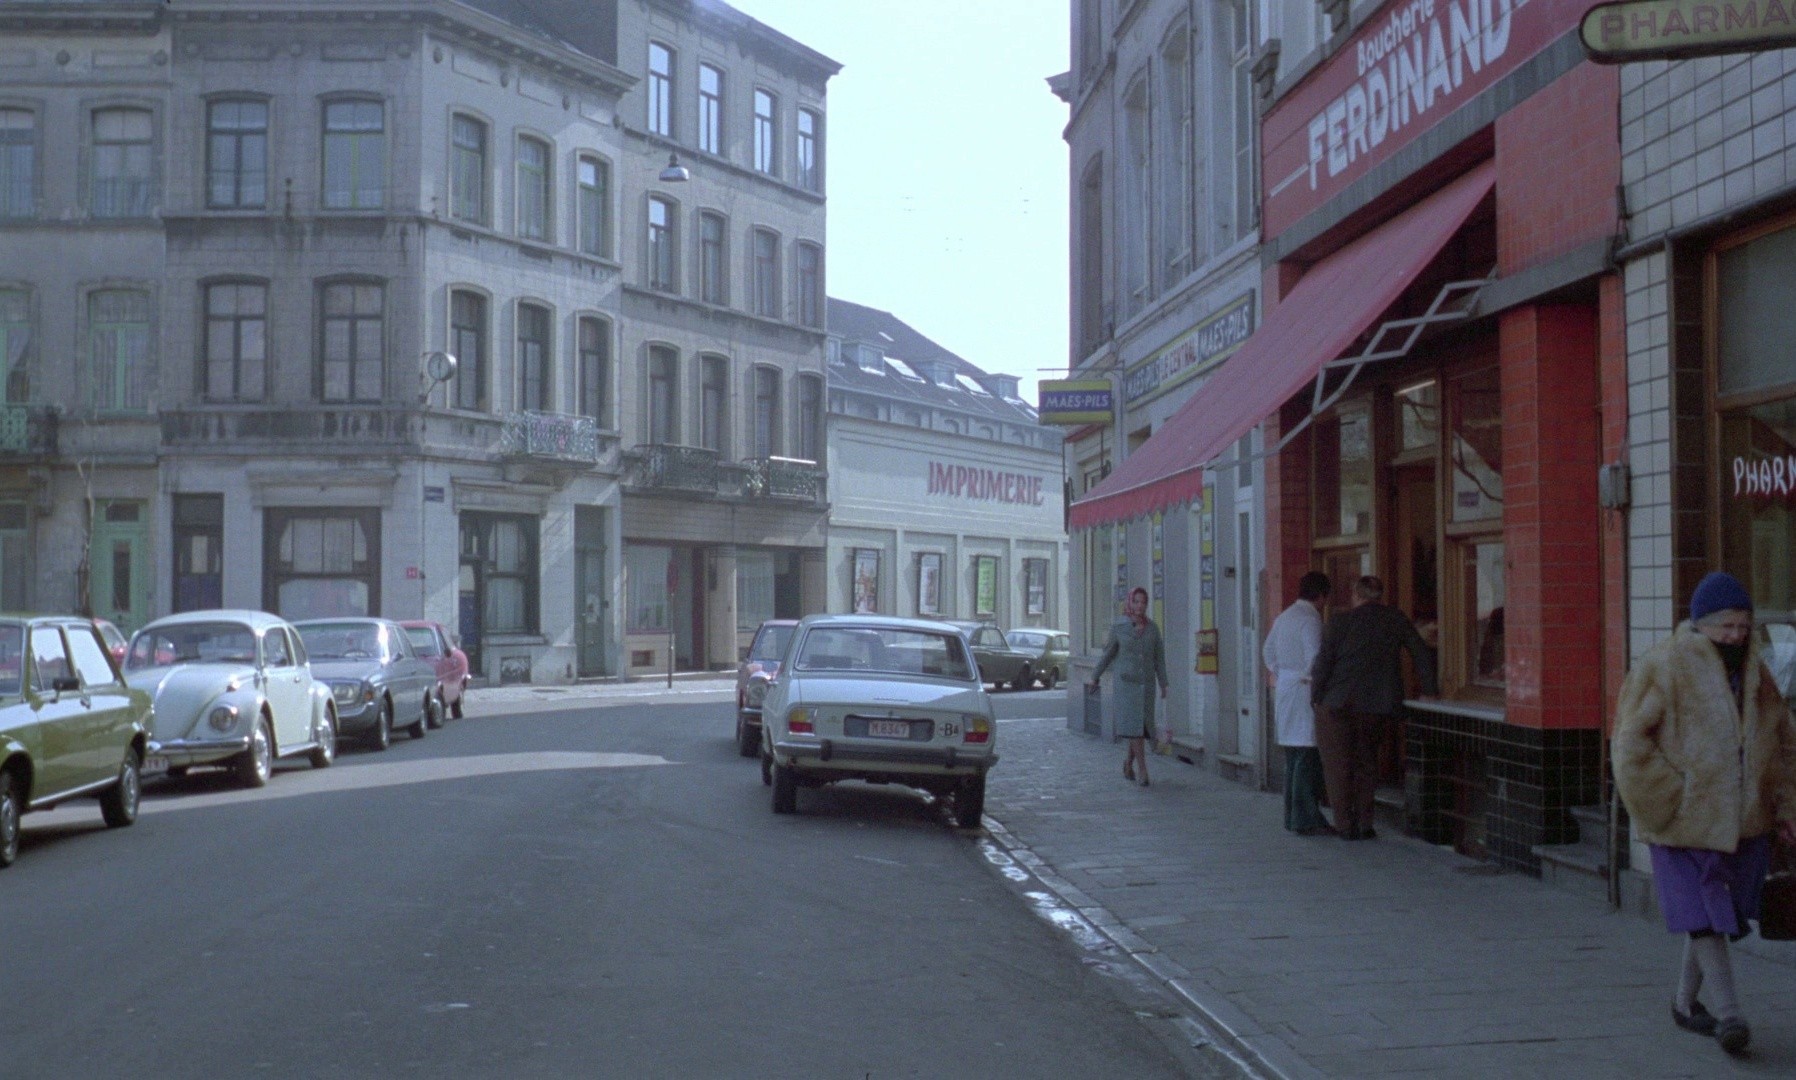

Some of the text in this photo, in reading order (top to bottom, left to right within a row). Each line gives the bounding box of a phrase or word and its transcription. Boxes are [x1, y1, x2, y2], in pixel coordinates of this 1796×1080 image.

[1357, 0, 1434, 77] Boucherie
[1600, 0, 1796, 43] PHARMA
[1308, 0, 1512, 191] FERDINAND
[927, 460, 1044, 506] IMPRIMERIE
